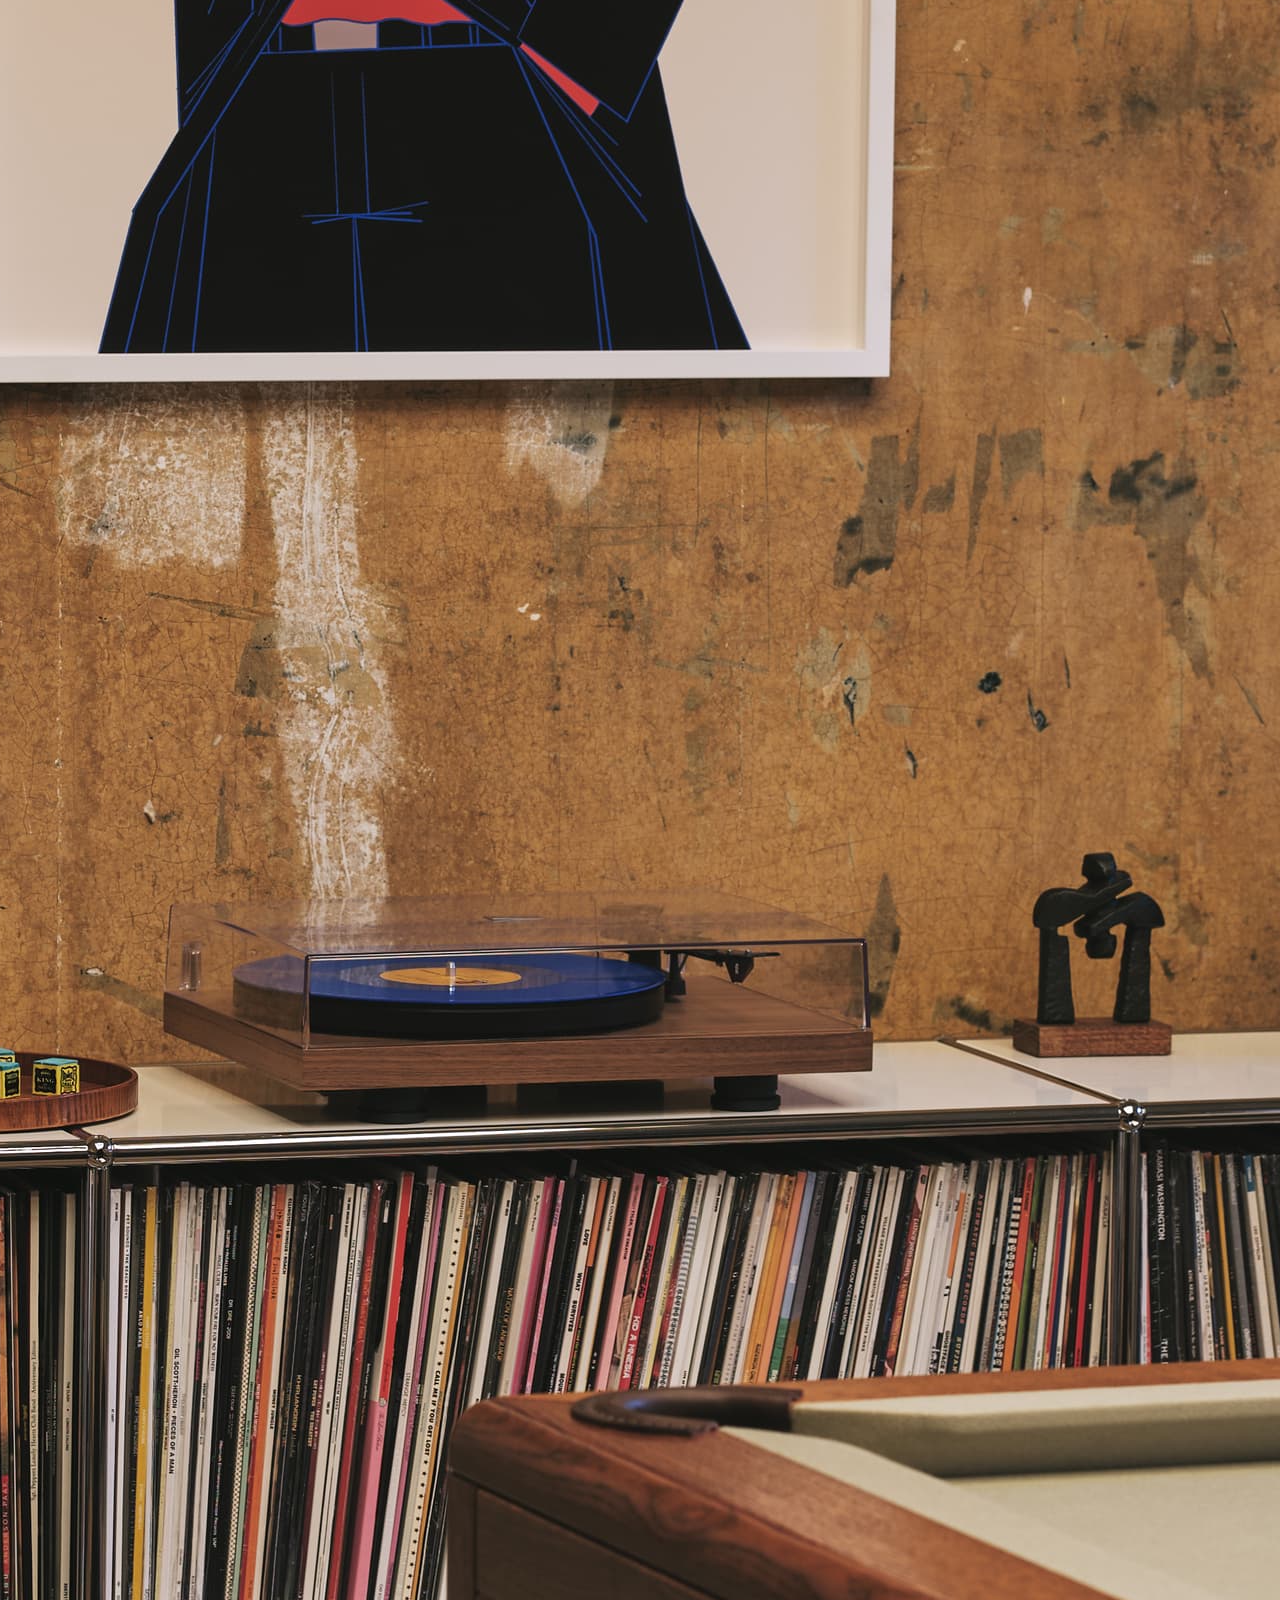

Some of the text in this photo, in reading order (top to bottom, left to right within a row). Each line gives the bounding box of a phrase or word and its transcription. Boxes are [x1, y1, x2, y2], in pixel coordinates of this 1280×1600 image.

[1155, 1150, 1164, 1182] KAMASI
[285, 1198, 293, 1229] ELLINGTON
[858, 1214, 866, 1228] DAFT
[1156, 1183, 1166, 1241] WASHINGTON
[582, 1229, 590, 1246] LOVE
[877, 1237, 886, 1257] GREEN
[575, 1272, 583, 1292] WHAT
[848, 1259, 857, 1283] RANDOM
[871, 1258, 882, 1298] PRESERVATION
[951, 1193, 984, 1372] ASTHMATIC KITTY RECORDS SUFJAN
[503, 1287, 514, 1313] NATION
[845, 1284, 854, 1305] ACCESS
[502, 1314, 510, 1323] OF
[567, 1300, 578, 1333] SURVIVES
[622, 1244, 654, 1379] RADIOHEAD KID A MNESIA
[839, 1306, 850, 1336] MEMORIES
[171, 1361, 180, 1409] SCOTT-HERON
[402, 1372, 411, 1396] STRANGE
[432, 1387, 439, 1398] ME
[557, 1373, 566, 1393] MOUN
[169, 1441, 176, 1451] OF
